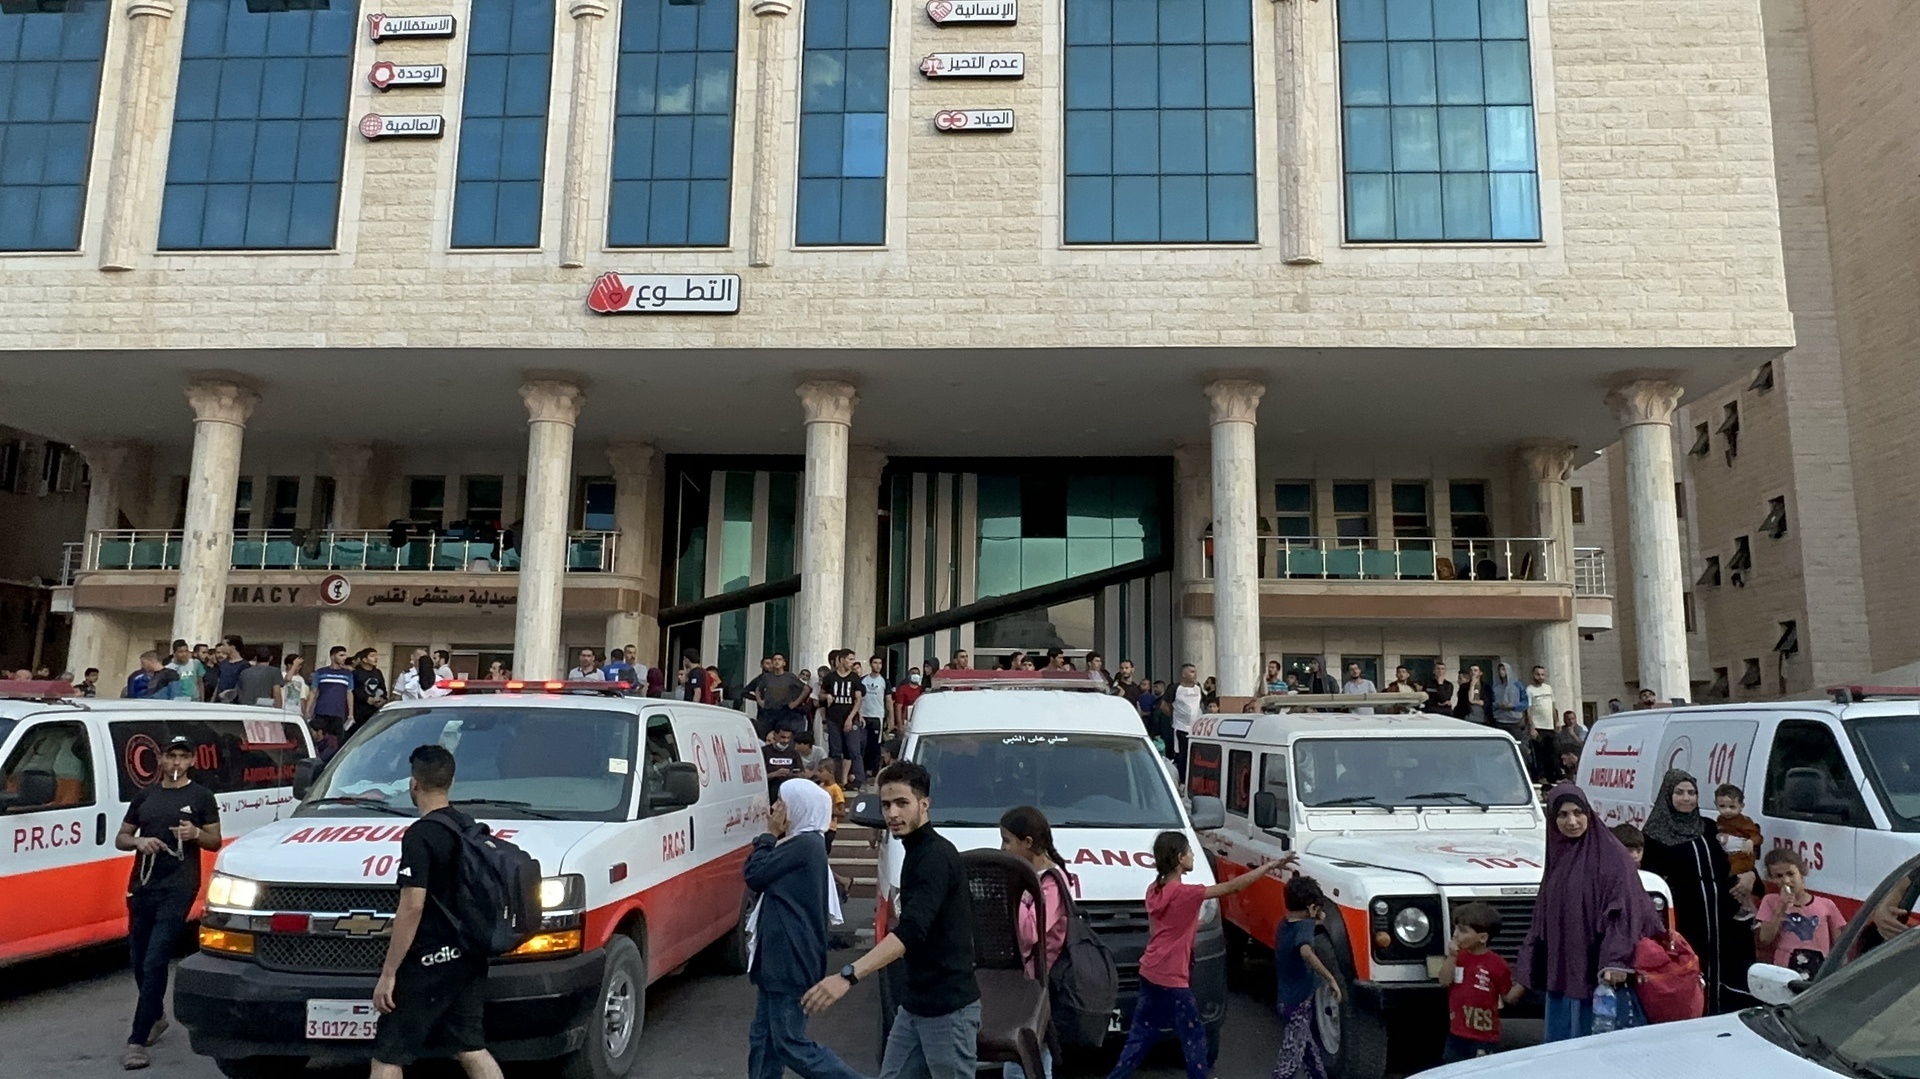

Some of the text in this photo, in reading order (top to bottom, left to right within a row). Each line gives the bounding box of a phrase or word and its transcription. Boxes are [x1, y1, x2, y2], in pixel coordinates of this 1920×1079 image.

[955, 3, 1014, 18] الإنسانية
[384, 19, 449, 33] الاستقلالية
[947, 56, 1018, 72] عدم التحيز
[397, 68, 439, 81] الوحدة
[385, 119, 437, 132] العالمية
[974, 112, 1009, 126] الحياد
[164, 587, 300, 603] PMACY
[1708, 742, 1738, 785] 101
[1589, 767, 1637, 789] AMBULANCE
[14, 821, 82, 853] P.R.C.S
[280, 826, 519, 844] AMBULE
[1773, 837, 1824, 871] PC.S
[1466, 857, 1543, 868] 101
[1462, 1005, 1494, 1032] YES
